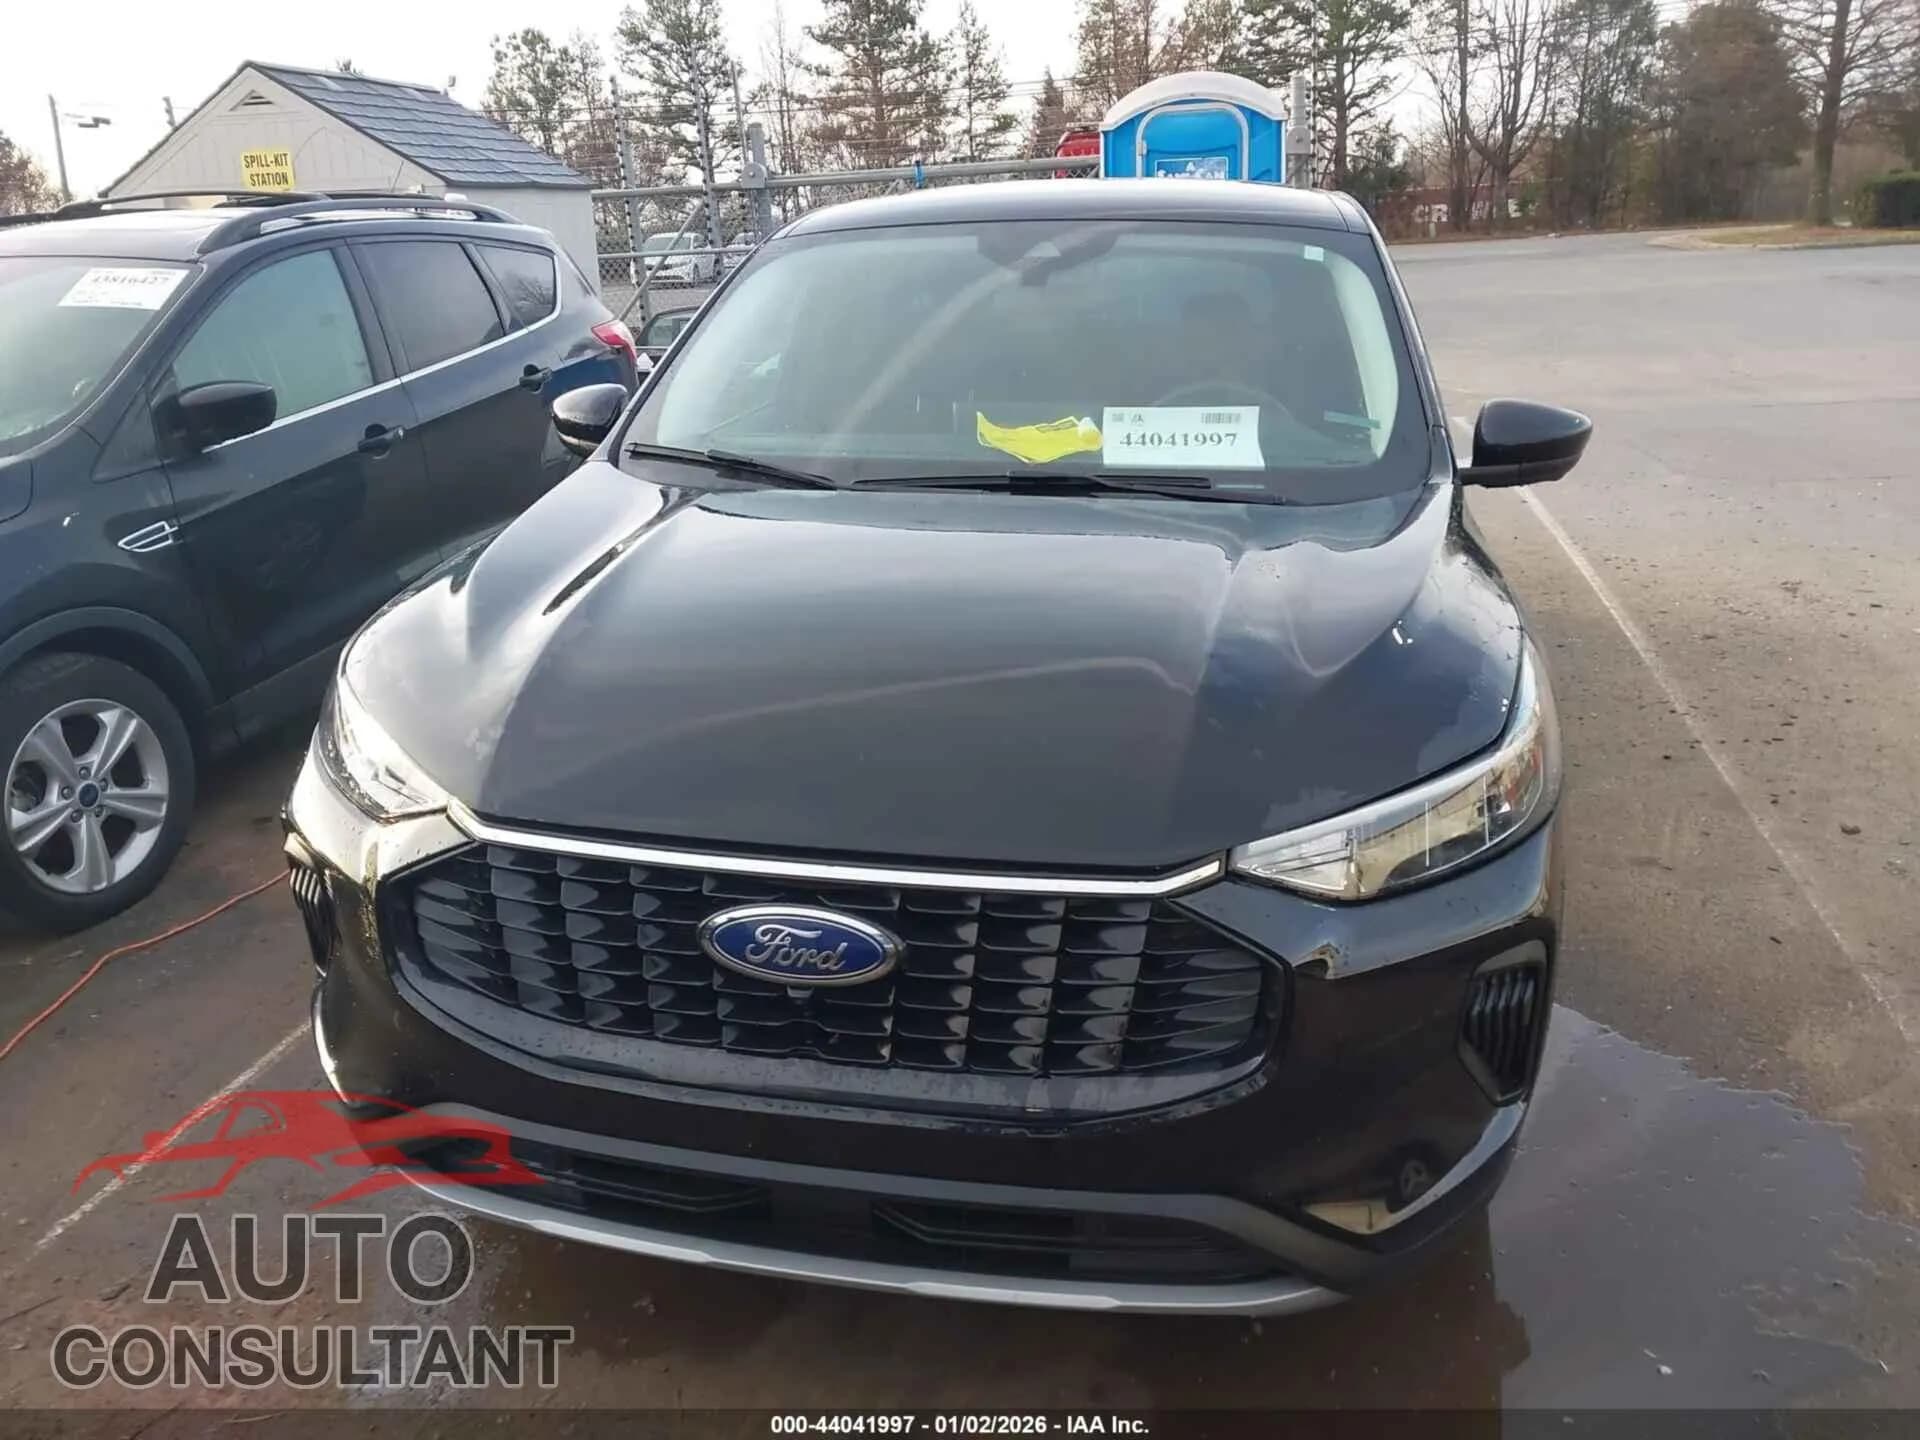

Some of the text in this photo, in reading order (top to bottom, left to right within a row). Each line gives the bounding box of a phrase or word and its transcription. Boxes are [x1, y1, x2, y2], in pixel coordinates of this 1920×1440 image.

[243, 152, 289, 169] SPILL-KIT
[249, 171, 289, 187] STATION
[1119, 431, 1238, 447] 44041997
[745, 924, 848, 970] Ford
